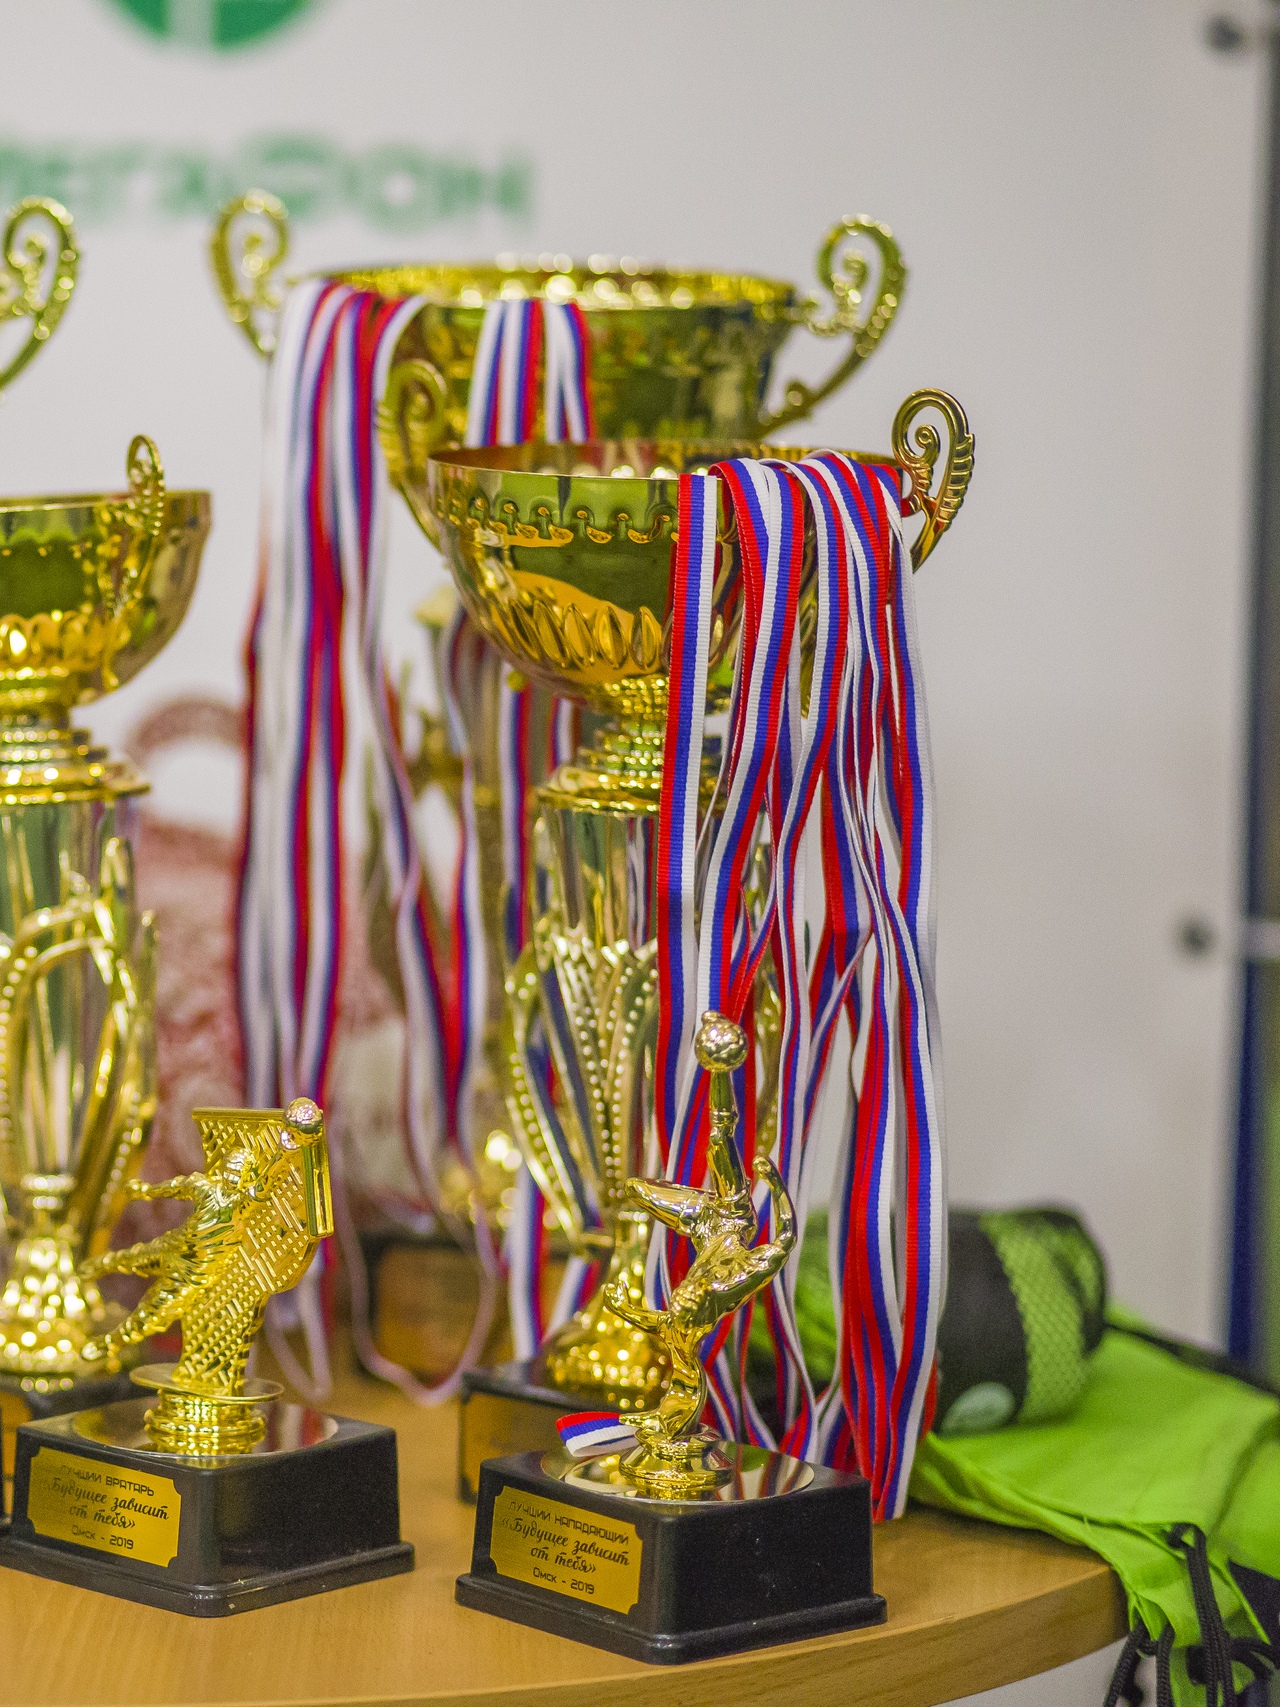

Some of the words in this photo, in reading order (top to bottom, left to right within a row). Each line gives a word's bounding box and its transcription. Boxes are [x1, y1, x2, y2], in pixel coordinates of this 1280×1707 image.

[105, 1476, 155, 1497] ВРАТАРЬ
[93, 1509, 136, 1529] тебя»
[110, 1497, 169, 1520] зависит
[508, 1501, 551, 1522] ЛУЧШИЙ
[554, 1514, 629, 1546] НАПАДАЮЩИЙ
[109, 1534, 134, 1550] 2019
[501, 1517, 569, 1547] «Будущее
[572, 1540, 630, 1566] зависит
[530, 1546, 550, 1562] от
[554, 1551, 597, 1574] тебя»
[532, 1566, 557, 1584] Омск
[570, 1578, 596, 1595] 2019
